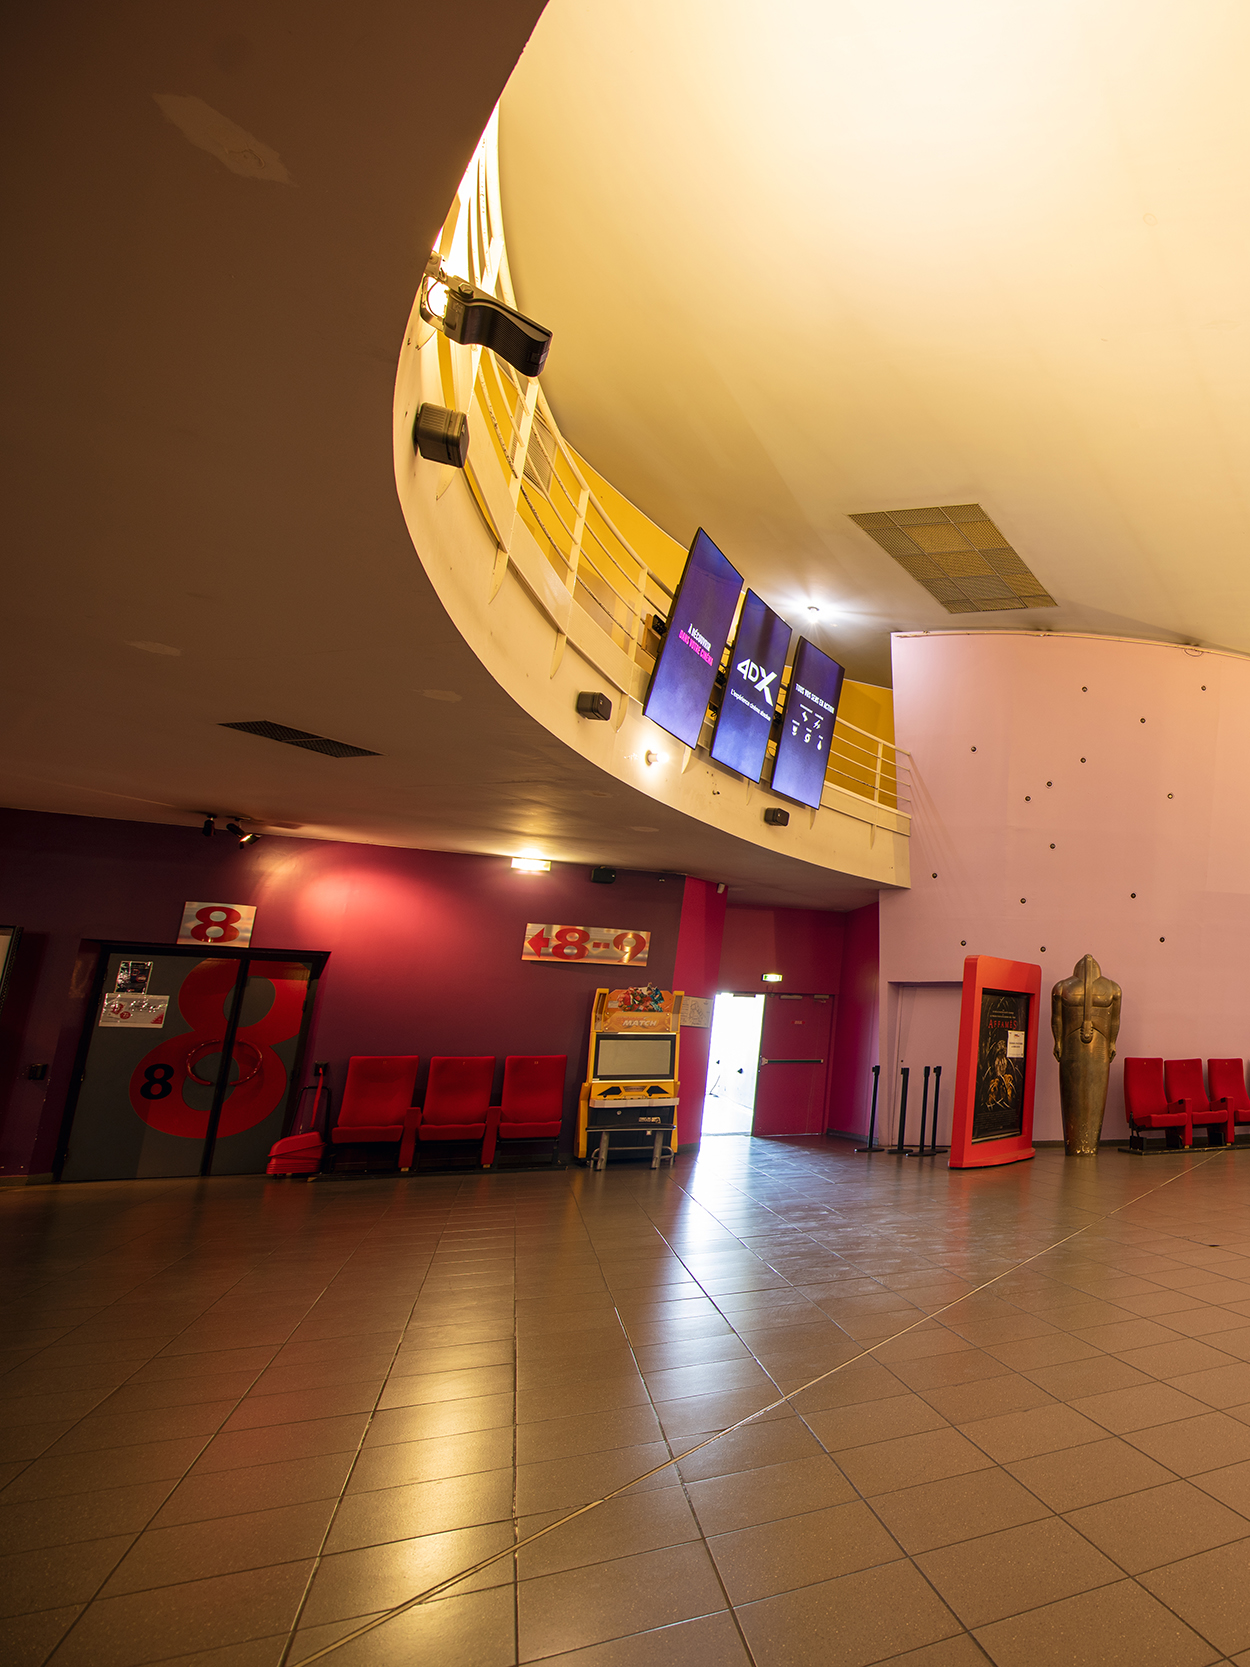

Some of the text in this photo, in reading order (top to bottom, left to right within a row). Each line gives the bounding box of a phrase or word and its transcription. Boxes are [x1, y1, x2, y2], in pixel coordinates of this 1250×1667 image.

[737, 659, 778, 707] 4DX
[190, 906, 242, 943] 8
[622, 1019, 657, 1027] MATCH
[129, 957, 311, 1139] 8
[140, 1063, 175, 1100] 8
